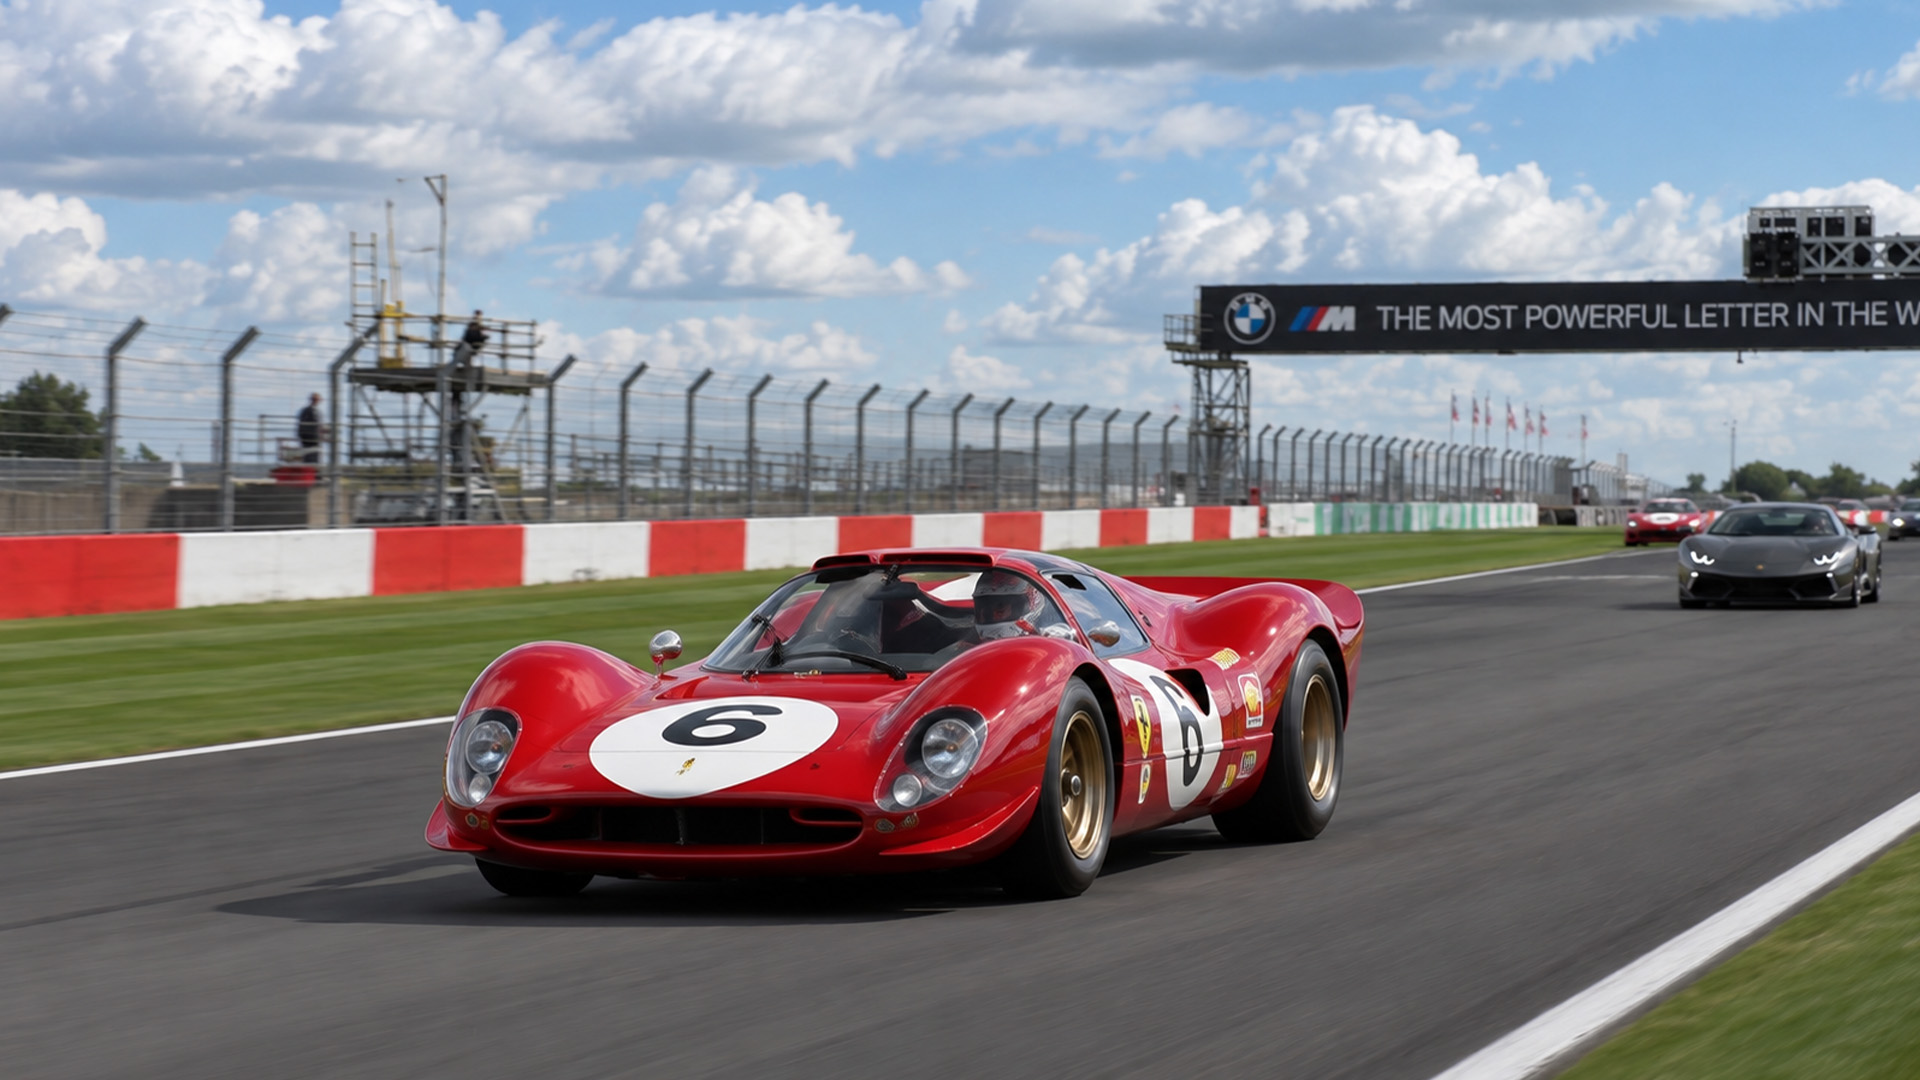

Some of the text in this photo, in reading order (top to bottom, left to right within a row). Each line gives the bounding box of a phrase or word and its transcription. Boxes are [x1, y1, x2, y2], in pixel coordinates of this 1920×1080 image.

[1376, 305, 1431, 331] THE
[1439, 304, 1519, 330] MOST
[1525, 303, 1678, 330] POWERFUL
[1684, 302, 1789, 328] LETTER
[1797, 302, 1824, 327] IN
[1831, 301, 1888, 327] THE
[661, 704, 783, 747] 6
[1150, 675, 1204, 786] 6
